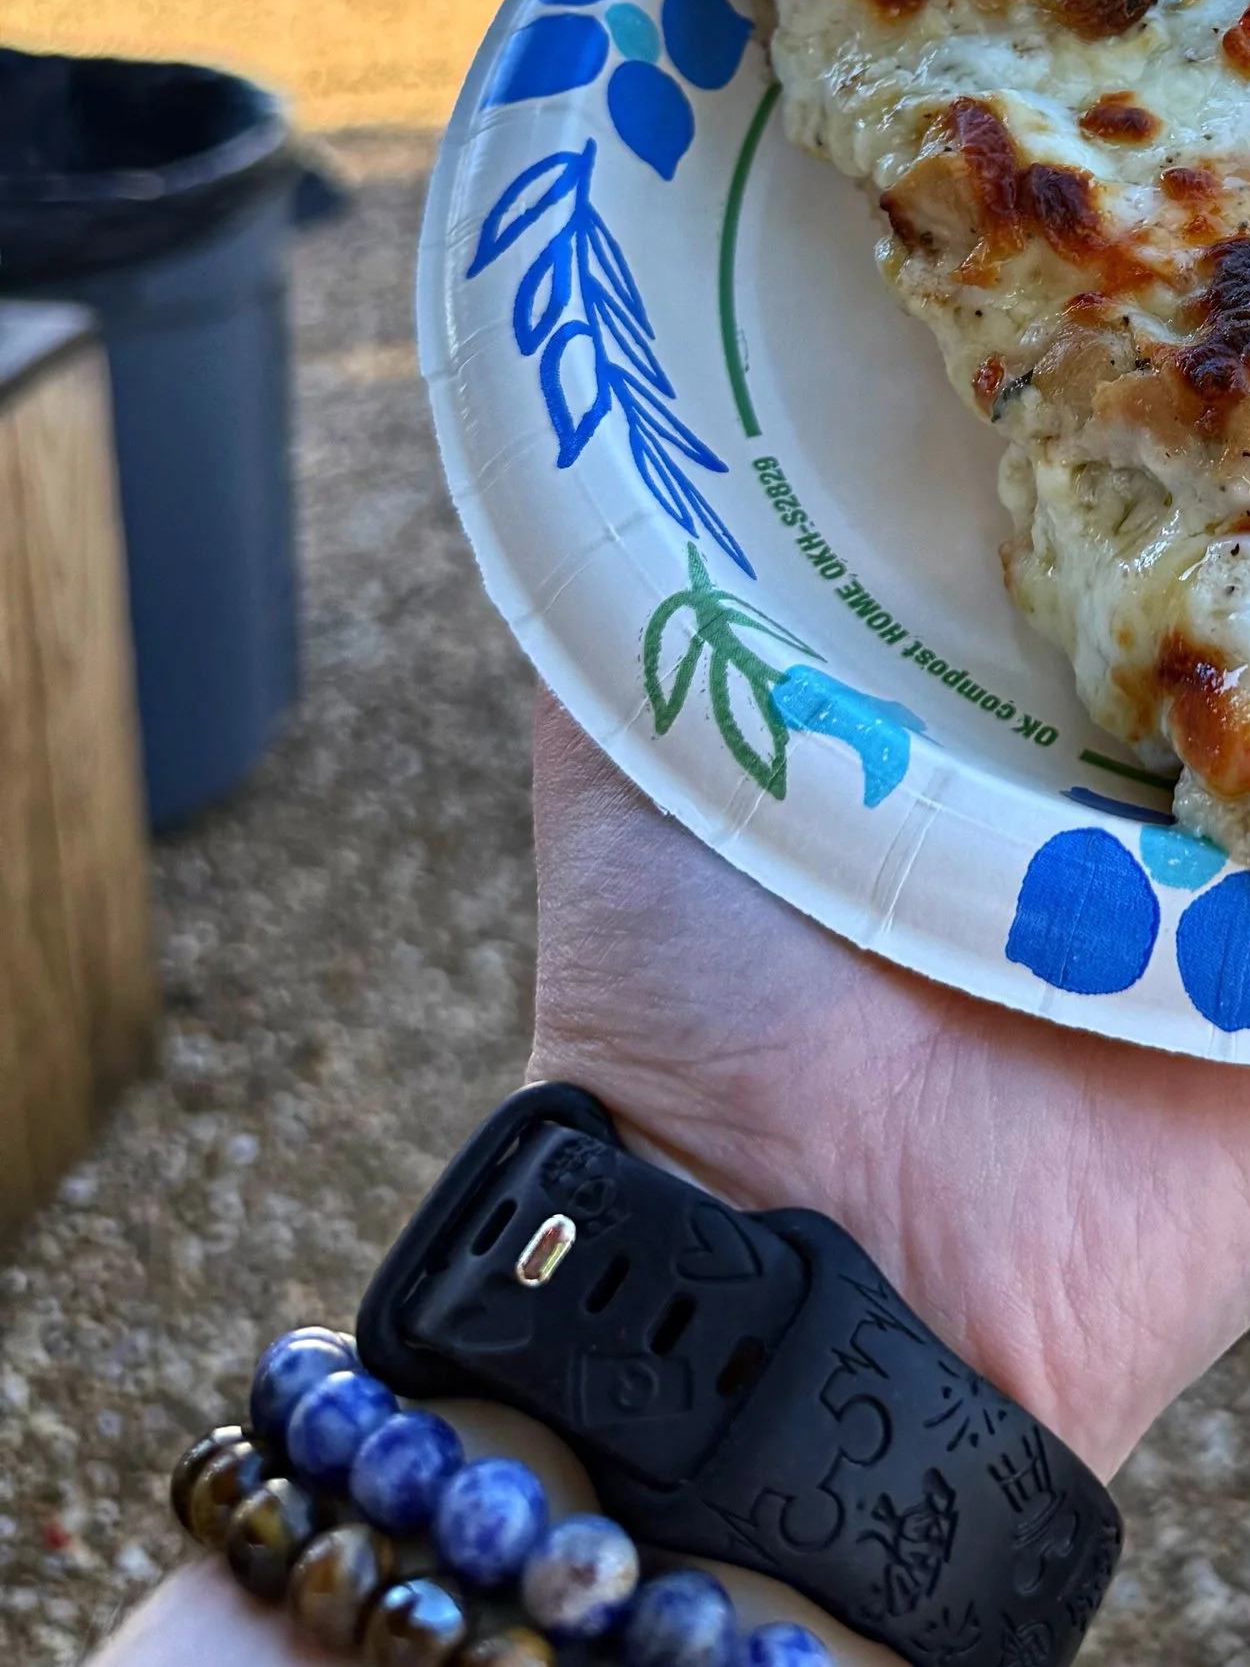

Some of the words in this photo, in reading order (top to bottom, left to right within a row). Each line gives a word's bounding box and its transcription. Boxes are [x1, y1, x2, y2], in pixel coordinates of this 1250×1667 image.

[753, 456, 847, 581] OKH-S2829
[901, 639, 1015, 720] compost
[1014, 714, 1059, 747] OK
